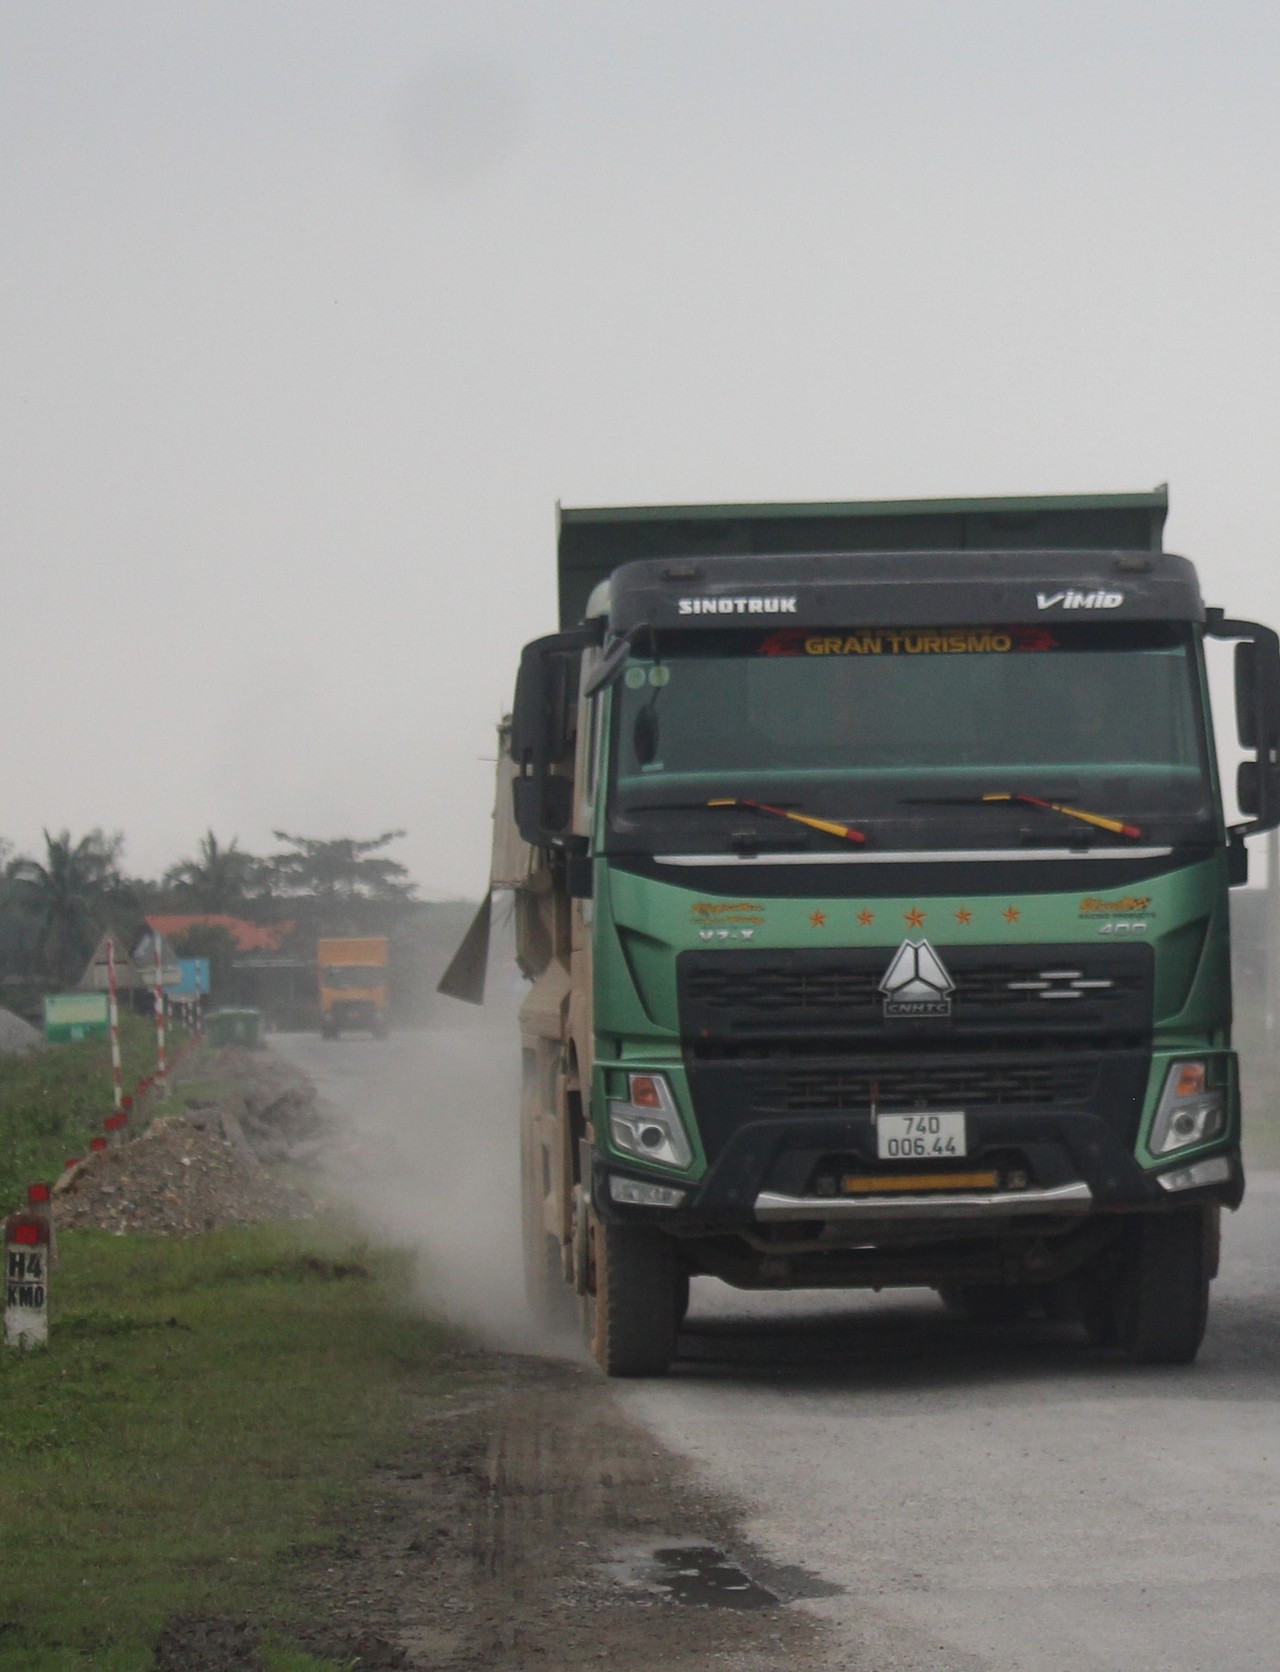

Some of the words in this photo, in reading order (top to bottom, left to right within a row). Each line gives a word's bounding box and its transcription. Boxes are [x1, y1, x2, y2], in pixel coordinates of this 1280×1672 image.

[678, 597, 798, 615] SINOTRUK
[804, 635, 882, 656] GRAN
[886, 633, 1013, 655] TURISMO
[887, 1002, 947, 1014] CNHTC
[887, 1137, 957, 1157] 006.44
[8, 1251, 43, 1279] H4
